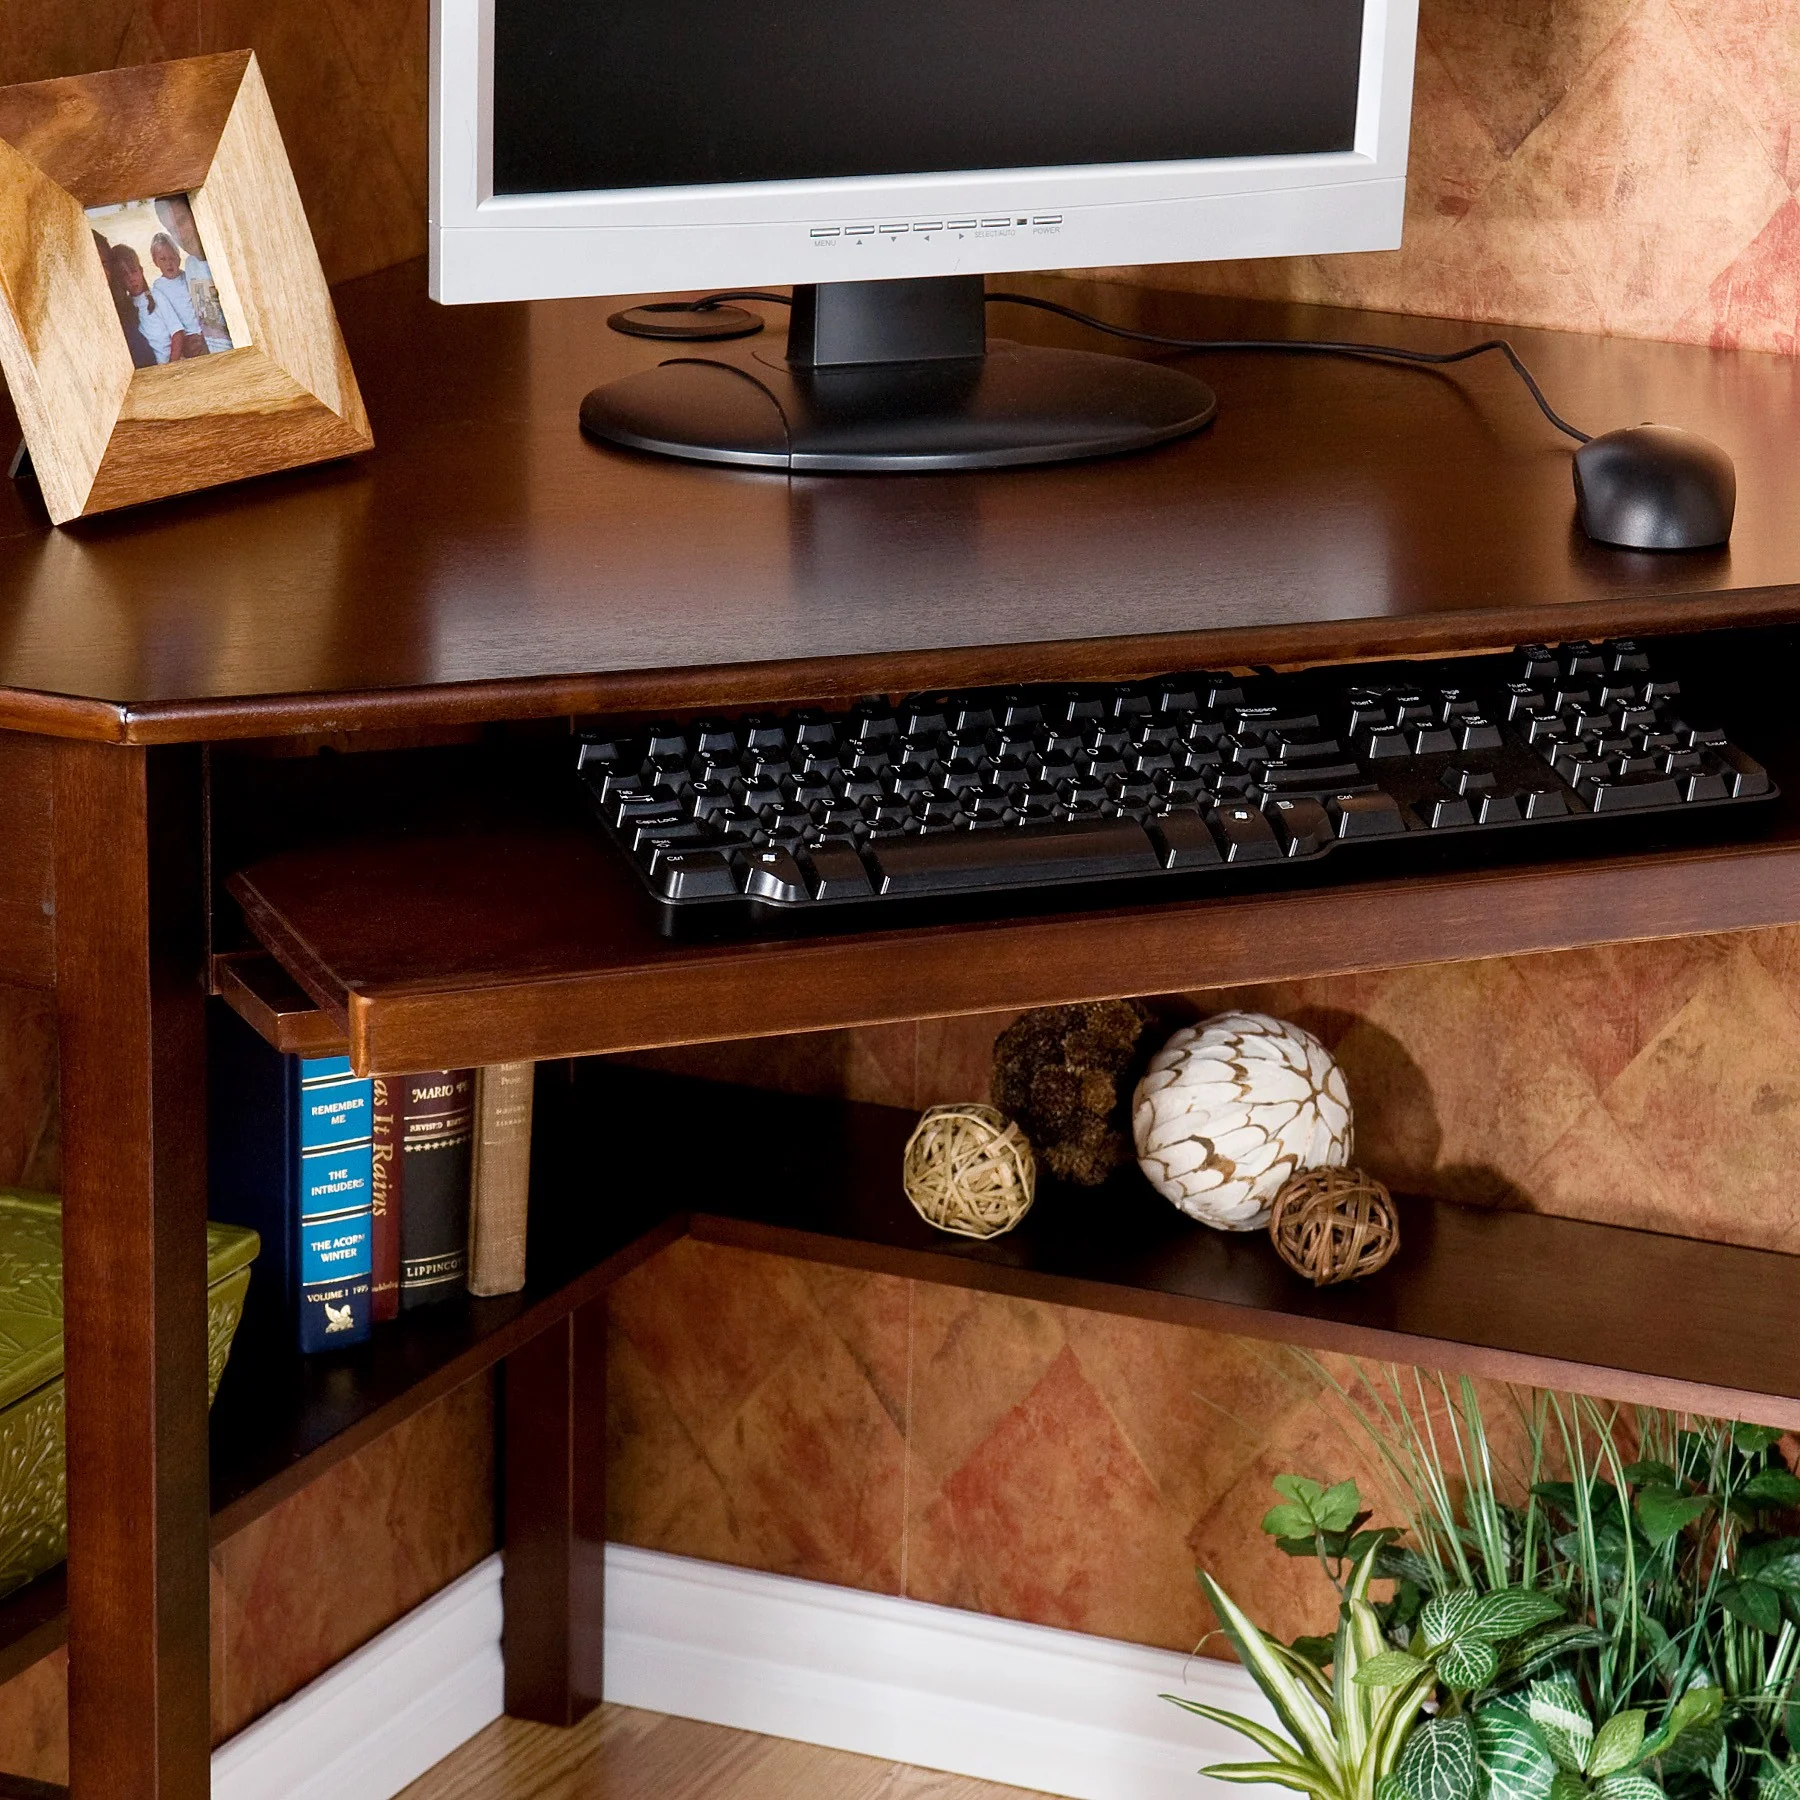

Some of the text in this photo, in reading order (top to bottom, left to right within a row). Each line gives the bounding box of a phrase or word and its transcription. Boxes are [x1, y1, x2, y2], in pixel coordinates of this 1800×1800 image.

[1032, 226, 1061, 235] POWER
[814, 239, 837, 247] MENU
[411, 1084, 454, 1103] MARIO
[311, 1098, 365, 1116] REMEMBER
[330, 1113, 347, 1125] ME
[373, 1114, 394, 1135] It
[409, 1121, 444, 1135] REVISED
[328, 1169, 349, 1181] THE
[372, 1143, 394, 1217] Rains
[311, 1178, 365, 1196] INTRUDERS
[311, 1233, 366, 1252] THE ACORN
[320, 1247, 358, 1263] WINTER
[306, 1289, 343, 1303] VOLUME
